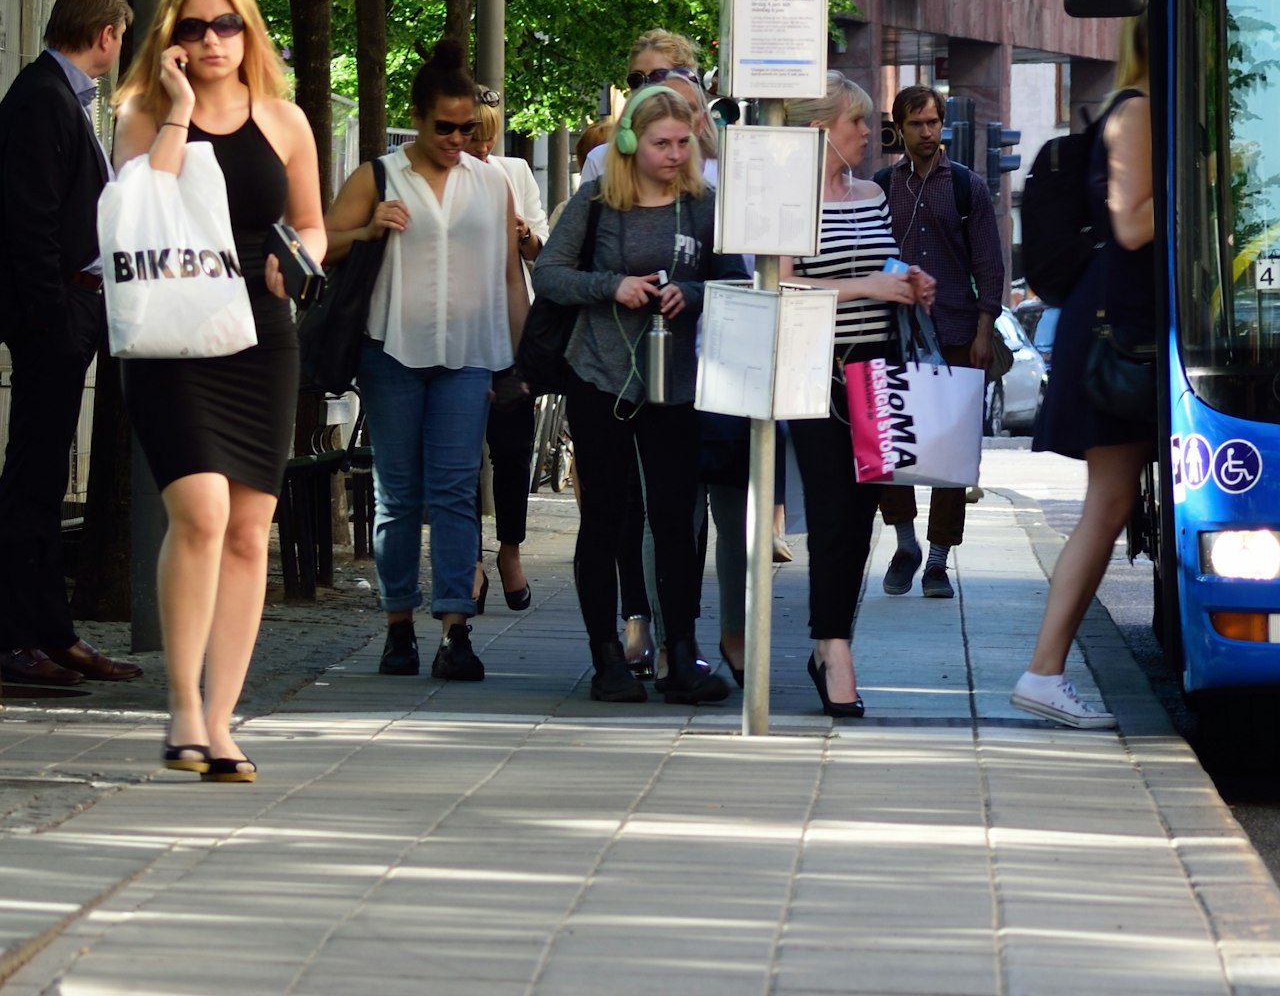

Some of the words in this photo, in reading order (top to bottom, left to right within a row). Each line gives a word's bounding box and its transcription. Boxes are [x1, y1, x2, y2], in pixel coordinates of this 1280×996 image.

[870, 358, 891, 419] DESIGN
[886, 362, 918, 470] MoMA
[877, 419, 897, 474] STORE
